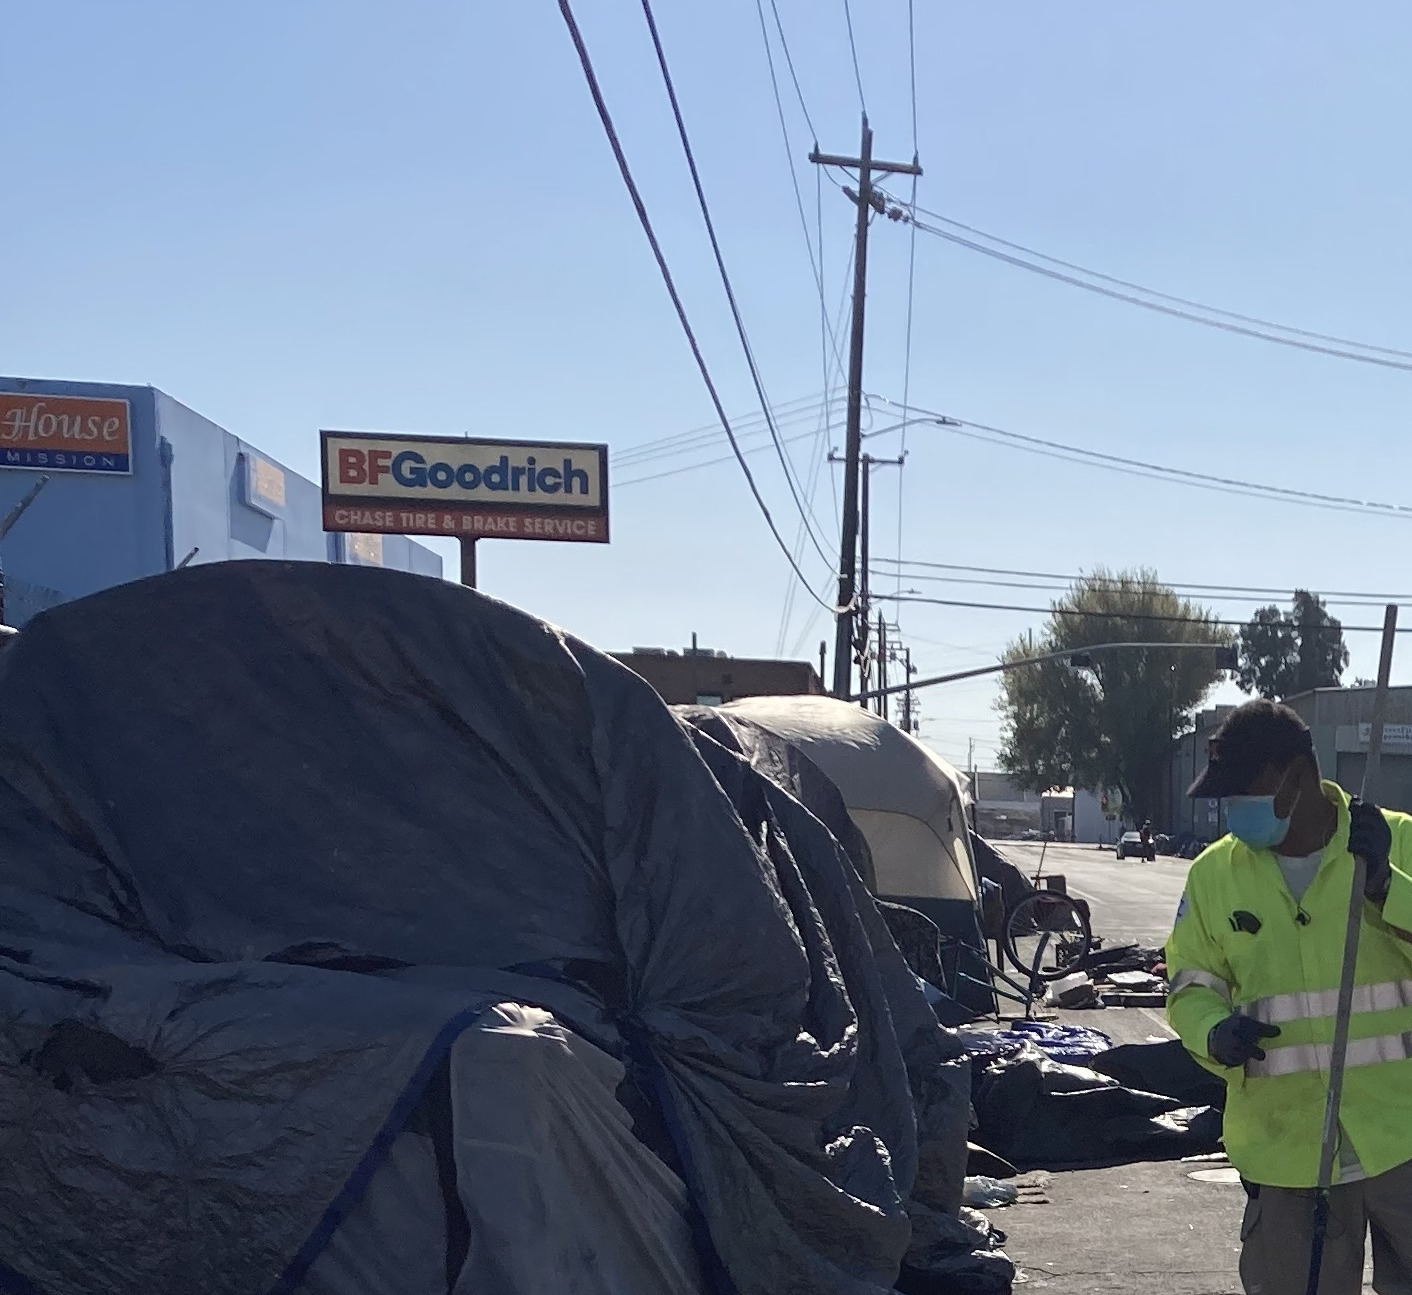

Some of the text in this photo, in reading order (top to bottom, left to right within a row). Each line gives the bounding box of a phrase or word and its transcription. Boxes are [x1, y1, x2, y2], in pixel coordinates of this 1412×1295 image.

[1, 402, 120, 441] House
[6, 450, 116, 467] MISSION
[337, 448, 590, 495] BFGoodrich
[335, 509, 597, 535] CHASE TIRE & BRAKE SERVICE
